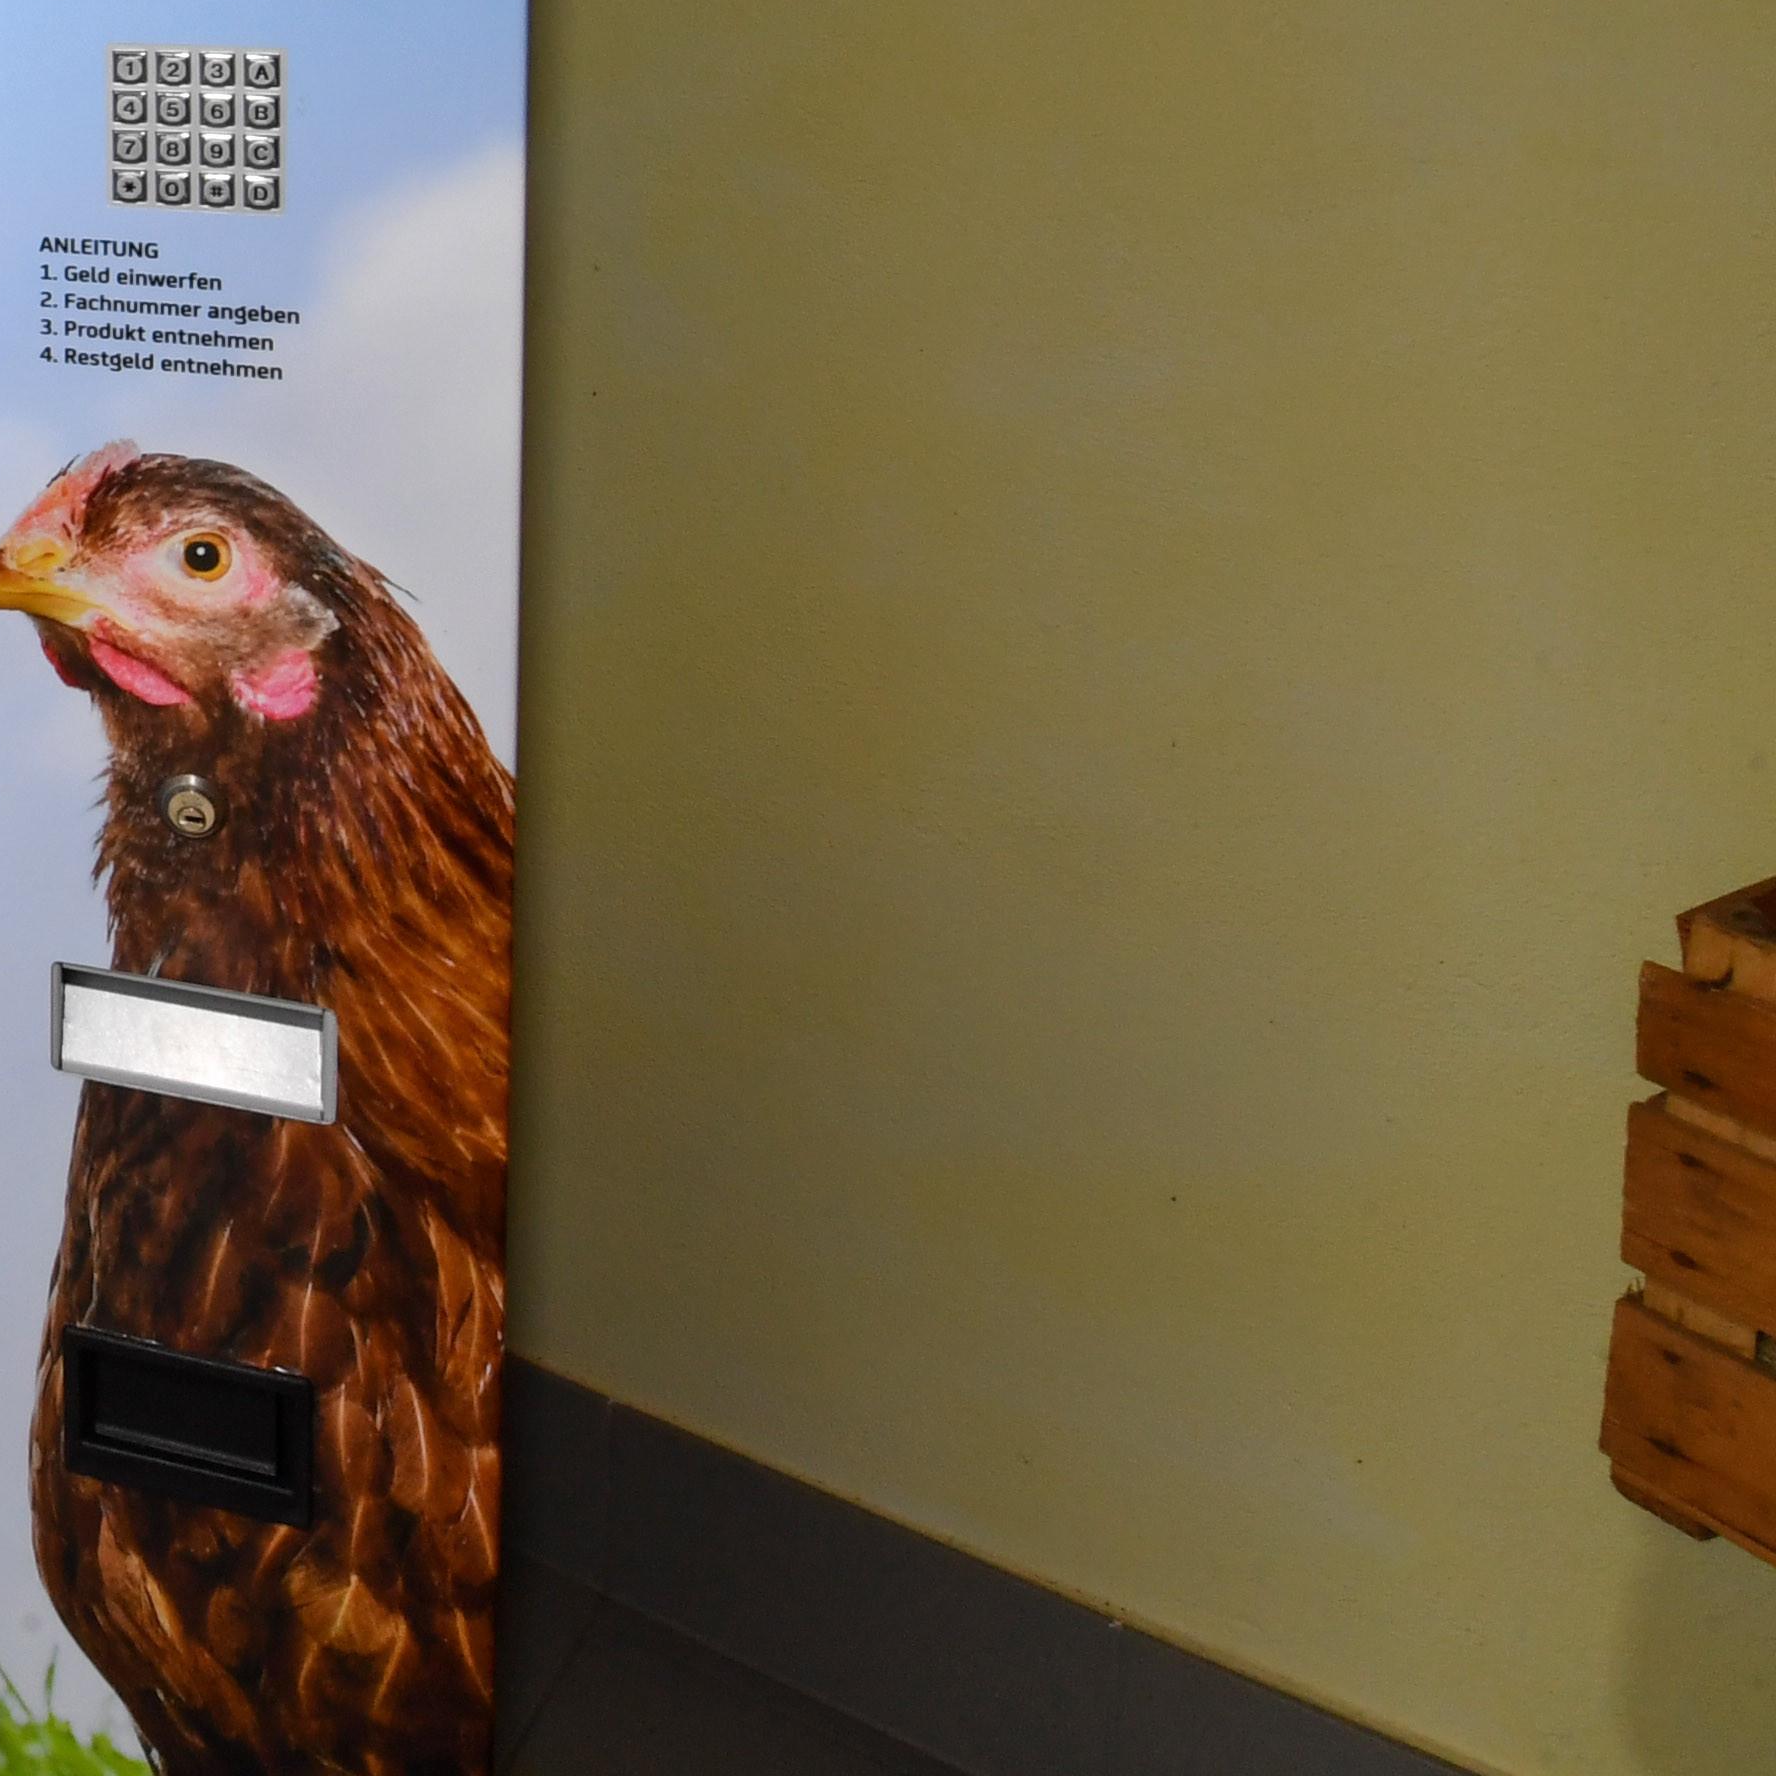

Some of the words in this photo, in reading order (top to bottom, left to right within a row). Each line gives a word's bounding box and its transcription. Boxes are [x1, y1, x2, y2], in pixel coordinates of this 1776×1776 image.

[125, 63, 134, 75] 1
[167, 62, 180, 78] 2
[211, 63, 224, 78] 3
[254, 63, 270, 81] A
[123, 100, 136, 115] 4
[166, 102, 179, 117] 5
[210, 103, 224, 119] 6
[254, 105, 268, 121] B
[123, 141, 136, 155] 7
[166, 142, 179, 156] 8
[210, 143, 223, 158] 9
[254, 144, 268, 161] C
[165, 182, 179, 196] 0
[210, 184, 224, 198] #
[254, 185, 268, 202] D
[39, 236, 159, 259] ANLEITUNG
[40, 264, 58, 281] 1.
[64, 265, 110, 283] Geld
[116, 268, 222, 291] einwerfen
[40, 292, 58, 309] 2.
[64, 293, 201, 318] Fachnummer
[207, 305, 300, 325] angeben
[40, 320, 58, 336] 3.
[64, 320, 146, 343] Produkt
[151, 328, 274, 351] entnehmen
[40, 348, 58, 364] 4.
[64, 348, 154, 372] Restgeld
[161, 356, 283, 380] entnehmen
